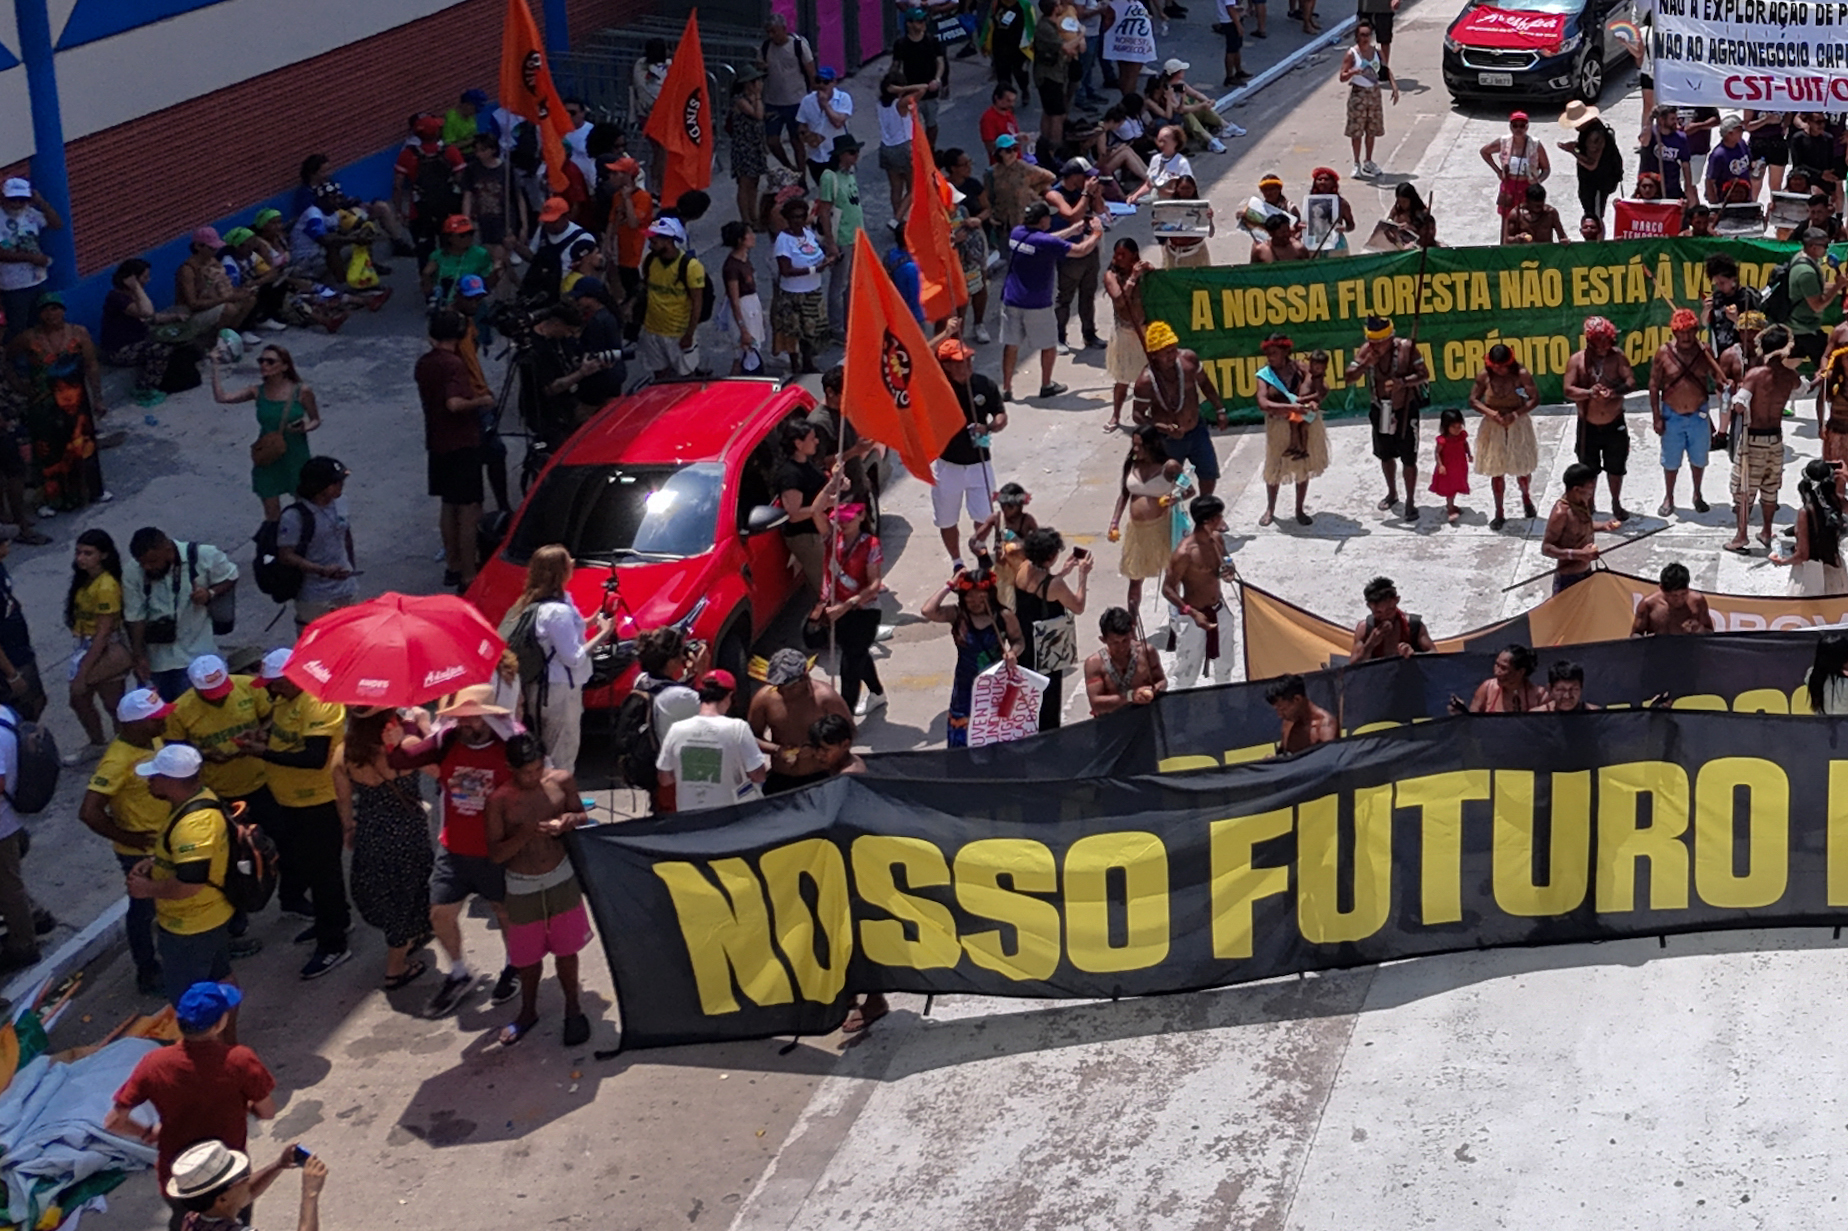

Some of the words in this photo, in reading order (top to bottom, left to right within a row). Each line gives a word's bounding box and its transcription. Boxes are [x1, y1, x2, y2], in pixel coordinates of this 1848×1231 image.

[1815, 2, 1835, 26] DE
[1655, 29, 1682, 61] NÃO
[1687, 36, 1703, 62] AO
[1708, 33, 1810, 68] AGRONEGÓCIO
[684, 97, 701, 144] SIND
[1191, 289, 1215, 331] A
[1221, 282, 1331, 330] NOSSA
[1337, 271, 1492, 318] FLORESTA
[1499, 259, 1564, 309] NÃO
[1573, 254, 1648, 306] ESTÁ
[1654, 252, 1674, 303] À
[652, 831, 1170, 1015] NOSSO
[1209, 757, 1790, 959] FUTURO
